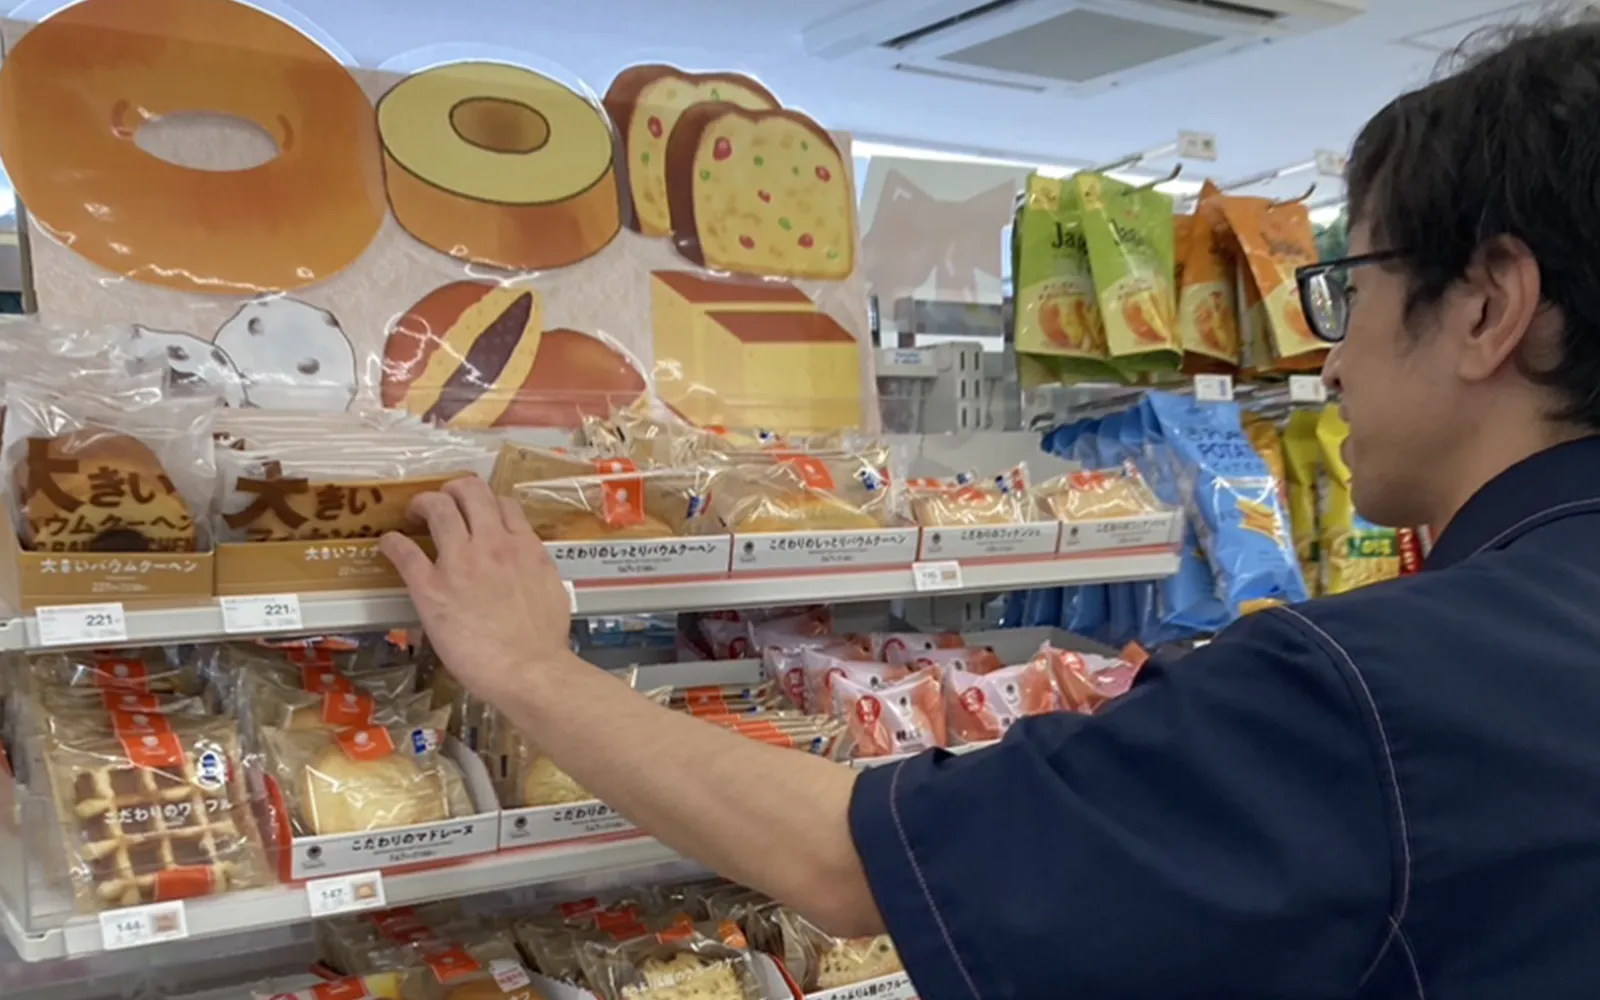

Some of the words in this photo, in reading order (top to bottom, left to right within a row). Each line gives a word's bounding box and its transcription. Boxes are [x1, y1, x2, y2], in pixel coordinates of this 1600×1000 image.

[223, 460, 383, 530] 大きい
[555, 543, 717, 560] こだわりのしっとりバウムクーヘン
[264, 604, 290, 616] 221
[85, 614, 113, 627] 221
[552, 805, 615, 822] こだわりの
[352, 825, 474, 851] こだわりのマドレーヌ
